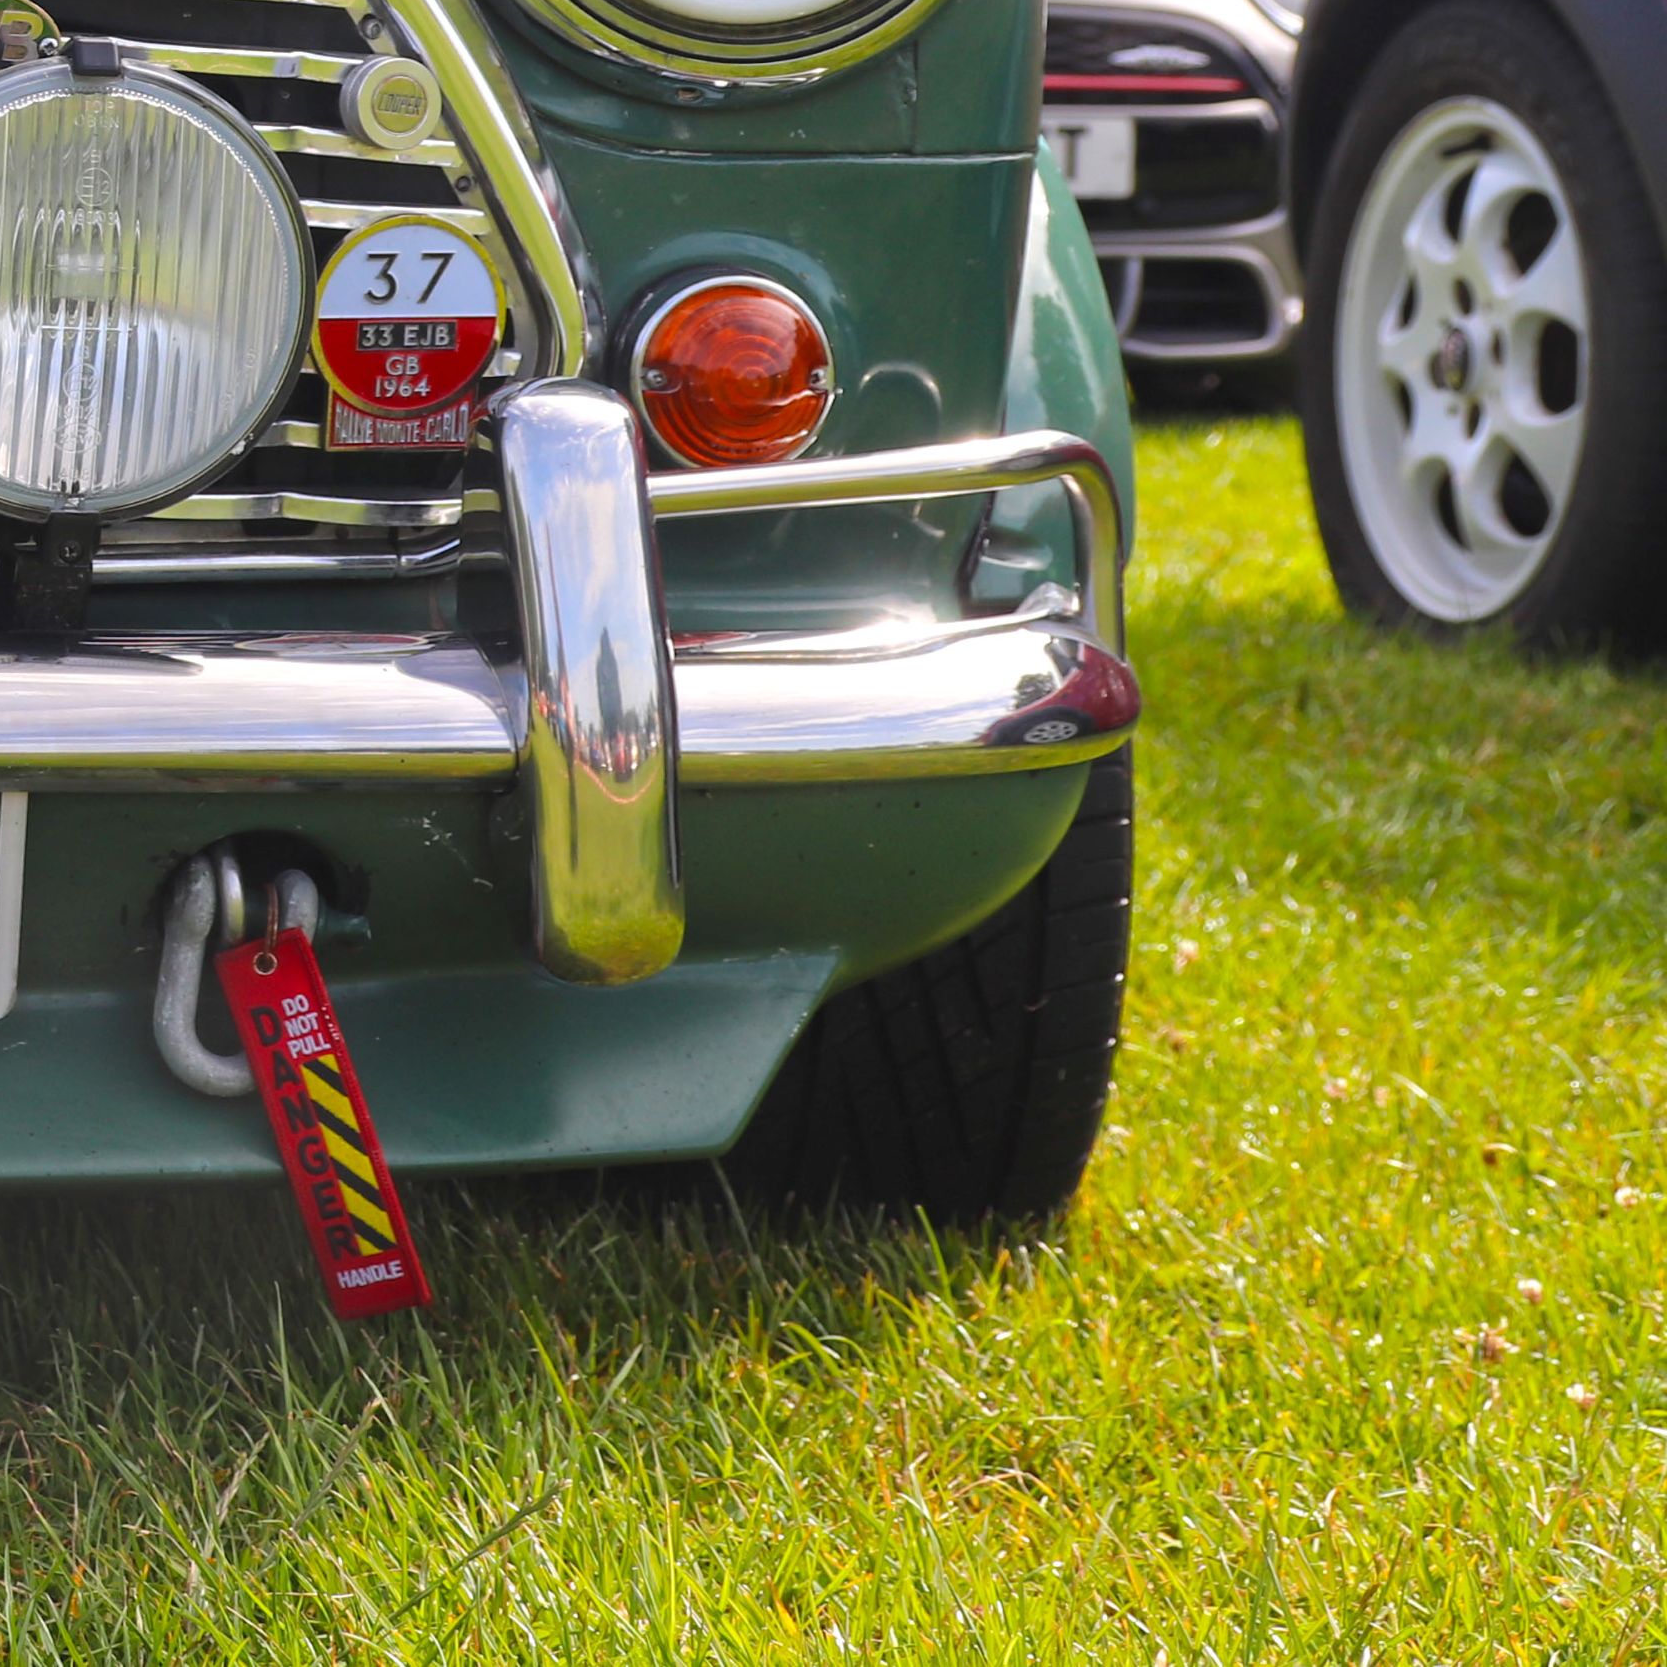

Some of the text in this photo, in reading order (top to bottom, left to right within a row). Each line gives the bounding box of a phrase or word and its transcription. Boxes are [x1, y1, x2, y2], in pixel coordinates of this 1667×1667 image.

[363, 251, 457, 306] 37
[362, 323, 450, 347] 33 EJB
[385, 355, 421, 376] GB
[375, 374, 432, 398] 1964
[282, 993, 310, 1017] DO
[284, 1012, 319, 1038] NOT
[287, 1032, 332, 1059] PULL
[250, 1006, 360, 1261] DANGER
[336, 1260, 405, 1289] HANDLE
